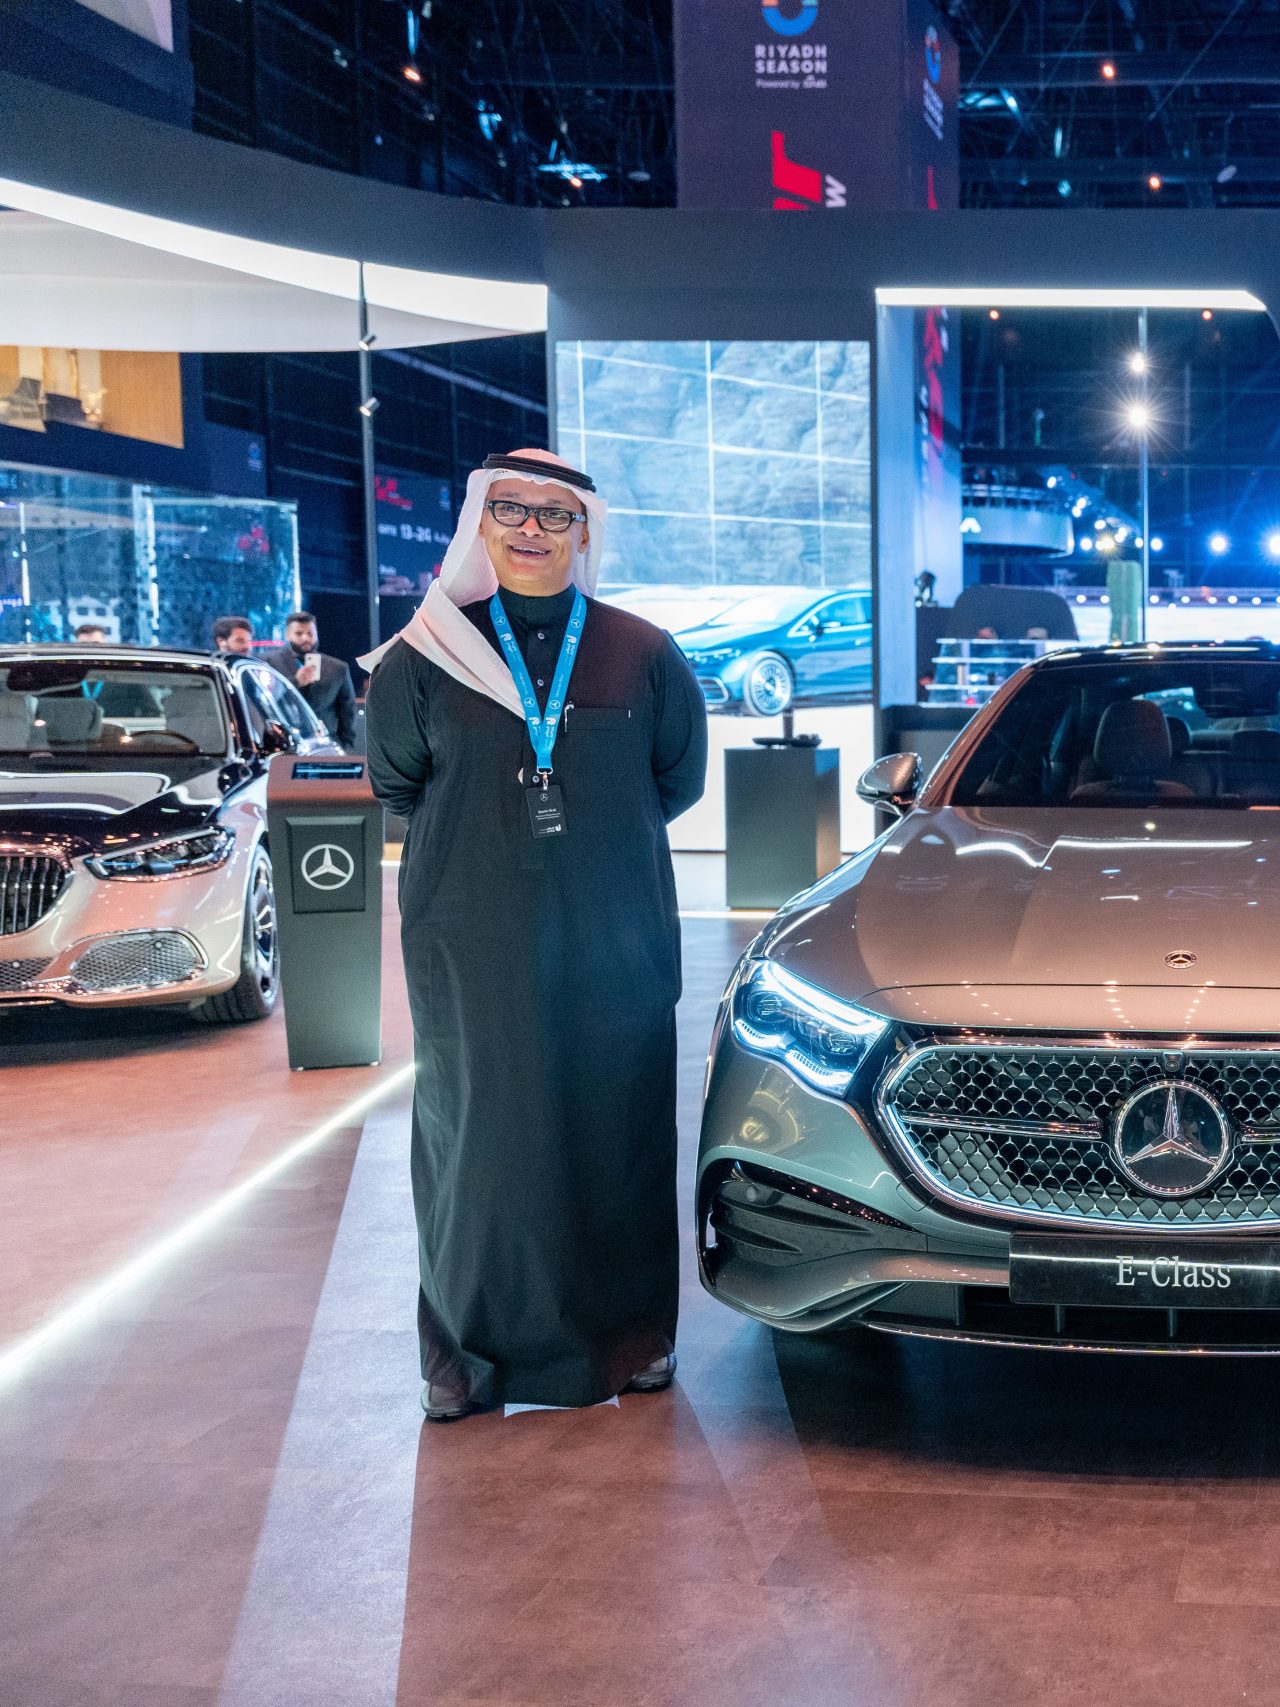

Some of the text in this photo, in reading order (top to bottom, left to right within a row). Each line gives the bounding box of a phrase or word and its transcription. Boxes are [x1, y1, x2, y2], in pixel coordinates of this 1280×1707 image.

[755, 44, 827, 58] RIYADH
[755, 60, 827, 74] SEASON
[756, 78, 789, 88] Powered
[1115, 1255, 1231, 1288] E-Class
